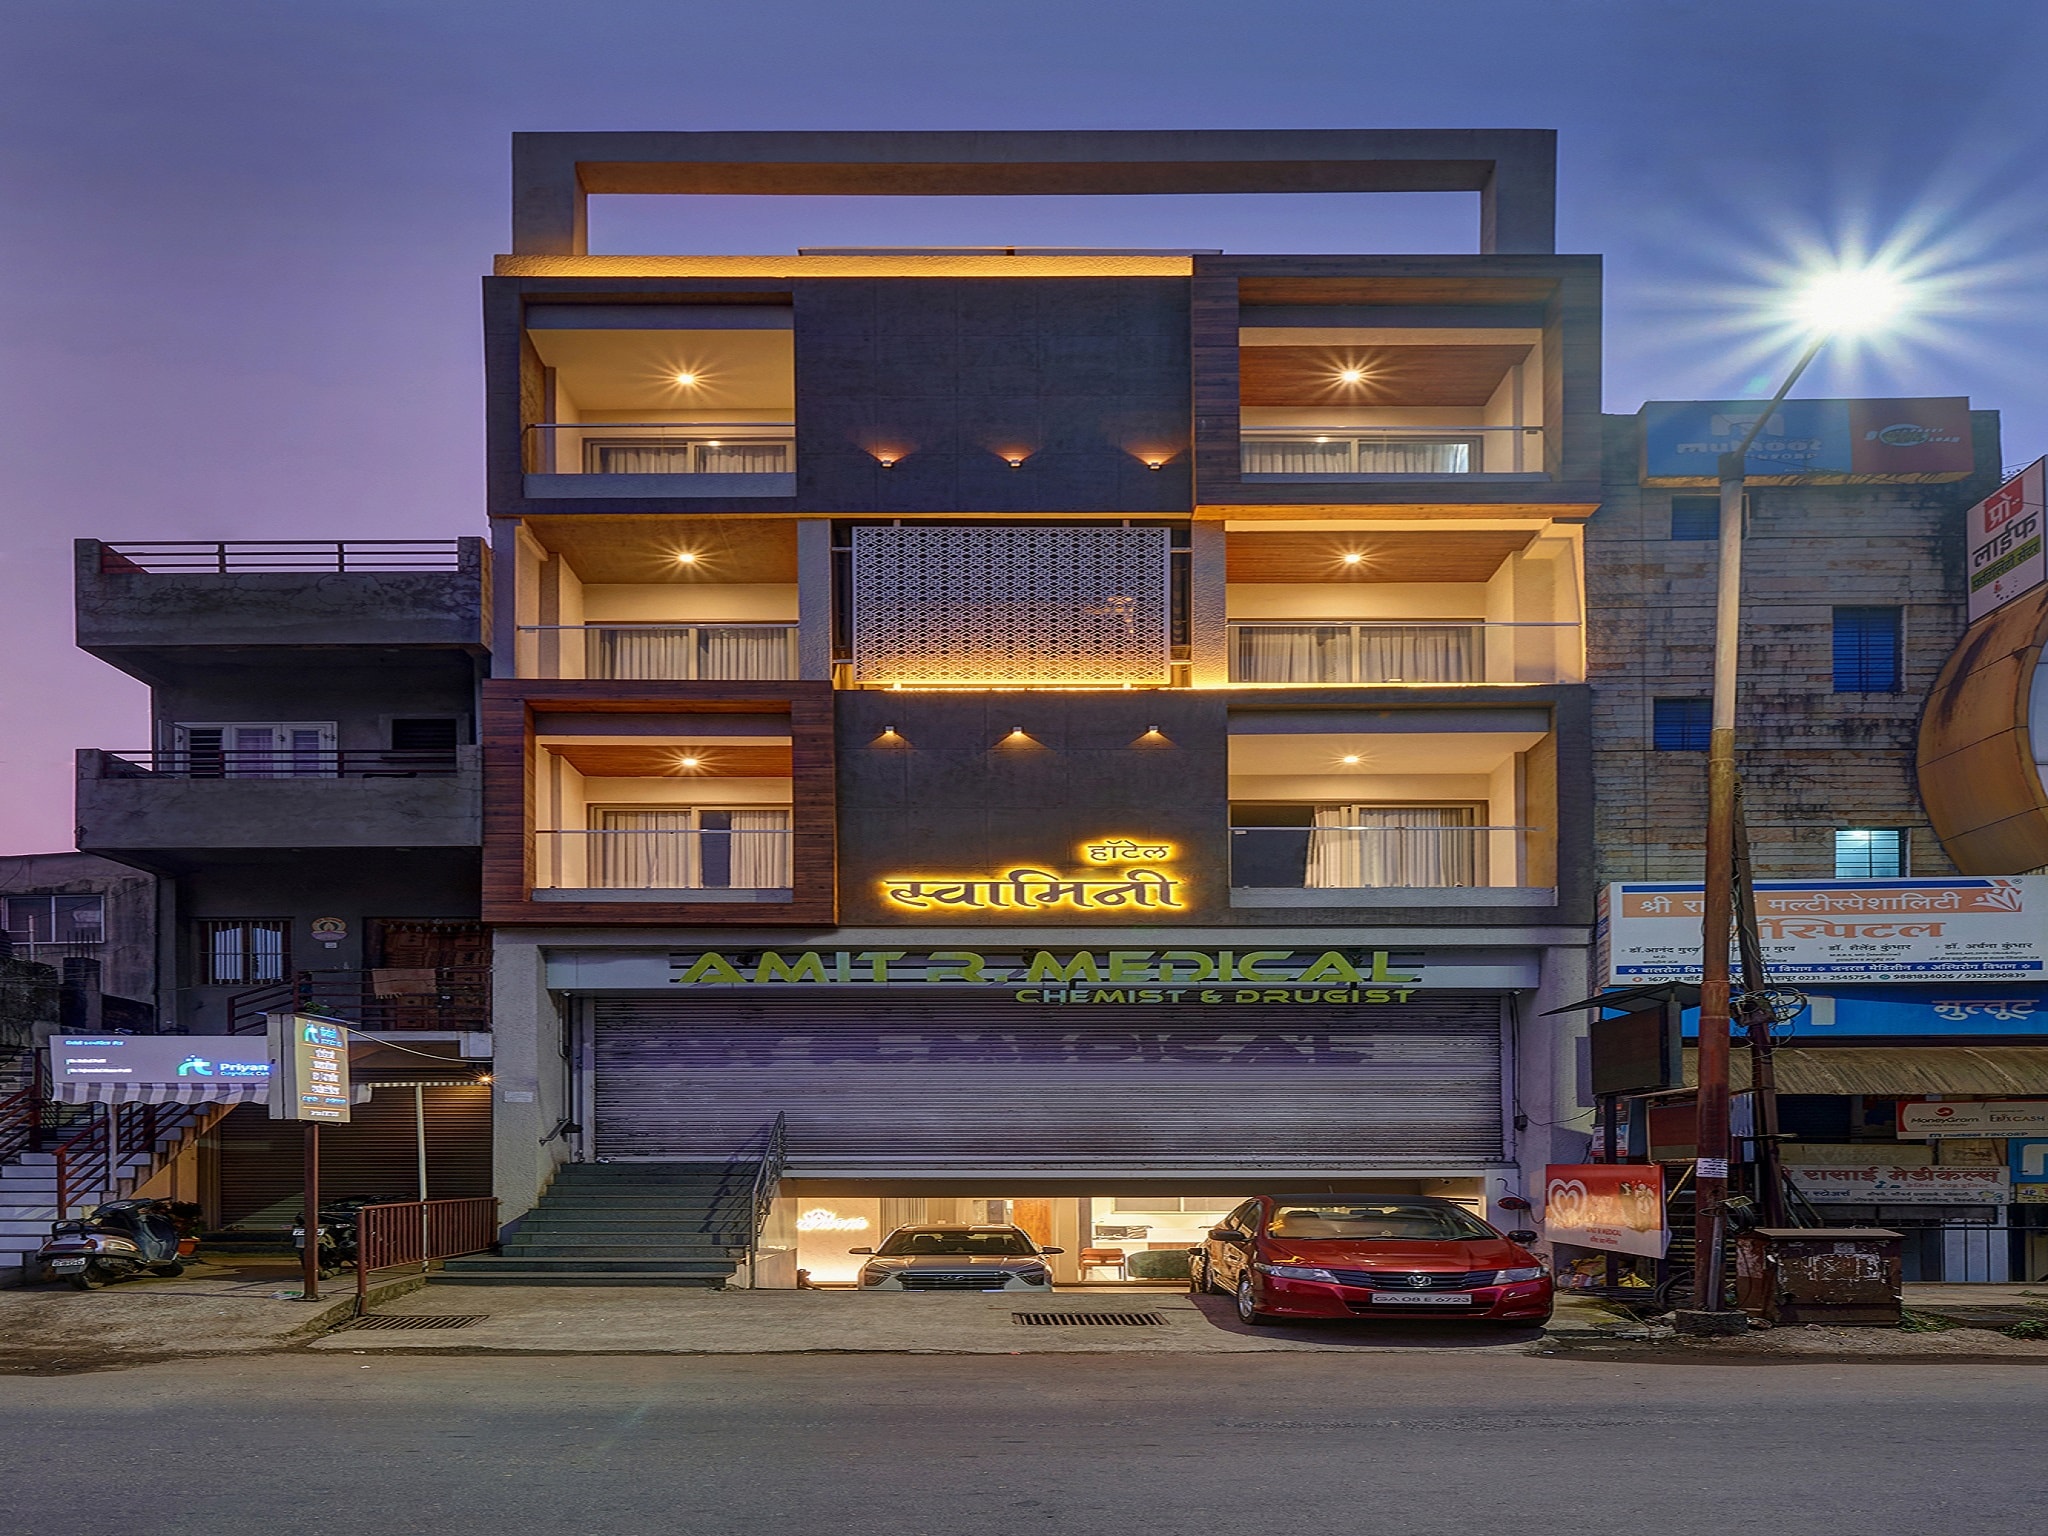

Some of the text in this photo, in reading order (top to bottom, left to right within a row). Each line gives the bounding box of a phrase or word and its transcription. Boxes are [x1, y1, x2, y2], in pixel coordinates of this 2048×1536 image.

[1972, 511, 2039, 568] लाईफ
[1087, 840, 1170, 861] हॉटेल
[885, 869, 1182, 907] स्वामिनी
[1640, 896, 1672, 913] श्री
[678, 951, 907, 983] AMIT
[1025, 950, 1424, 983] MEDICAL
[1015, 989, 1417, 1004] CHEMIST & DRUGIST
